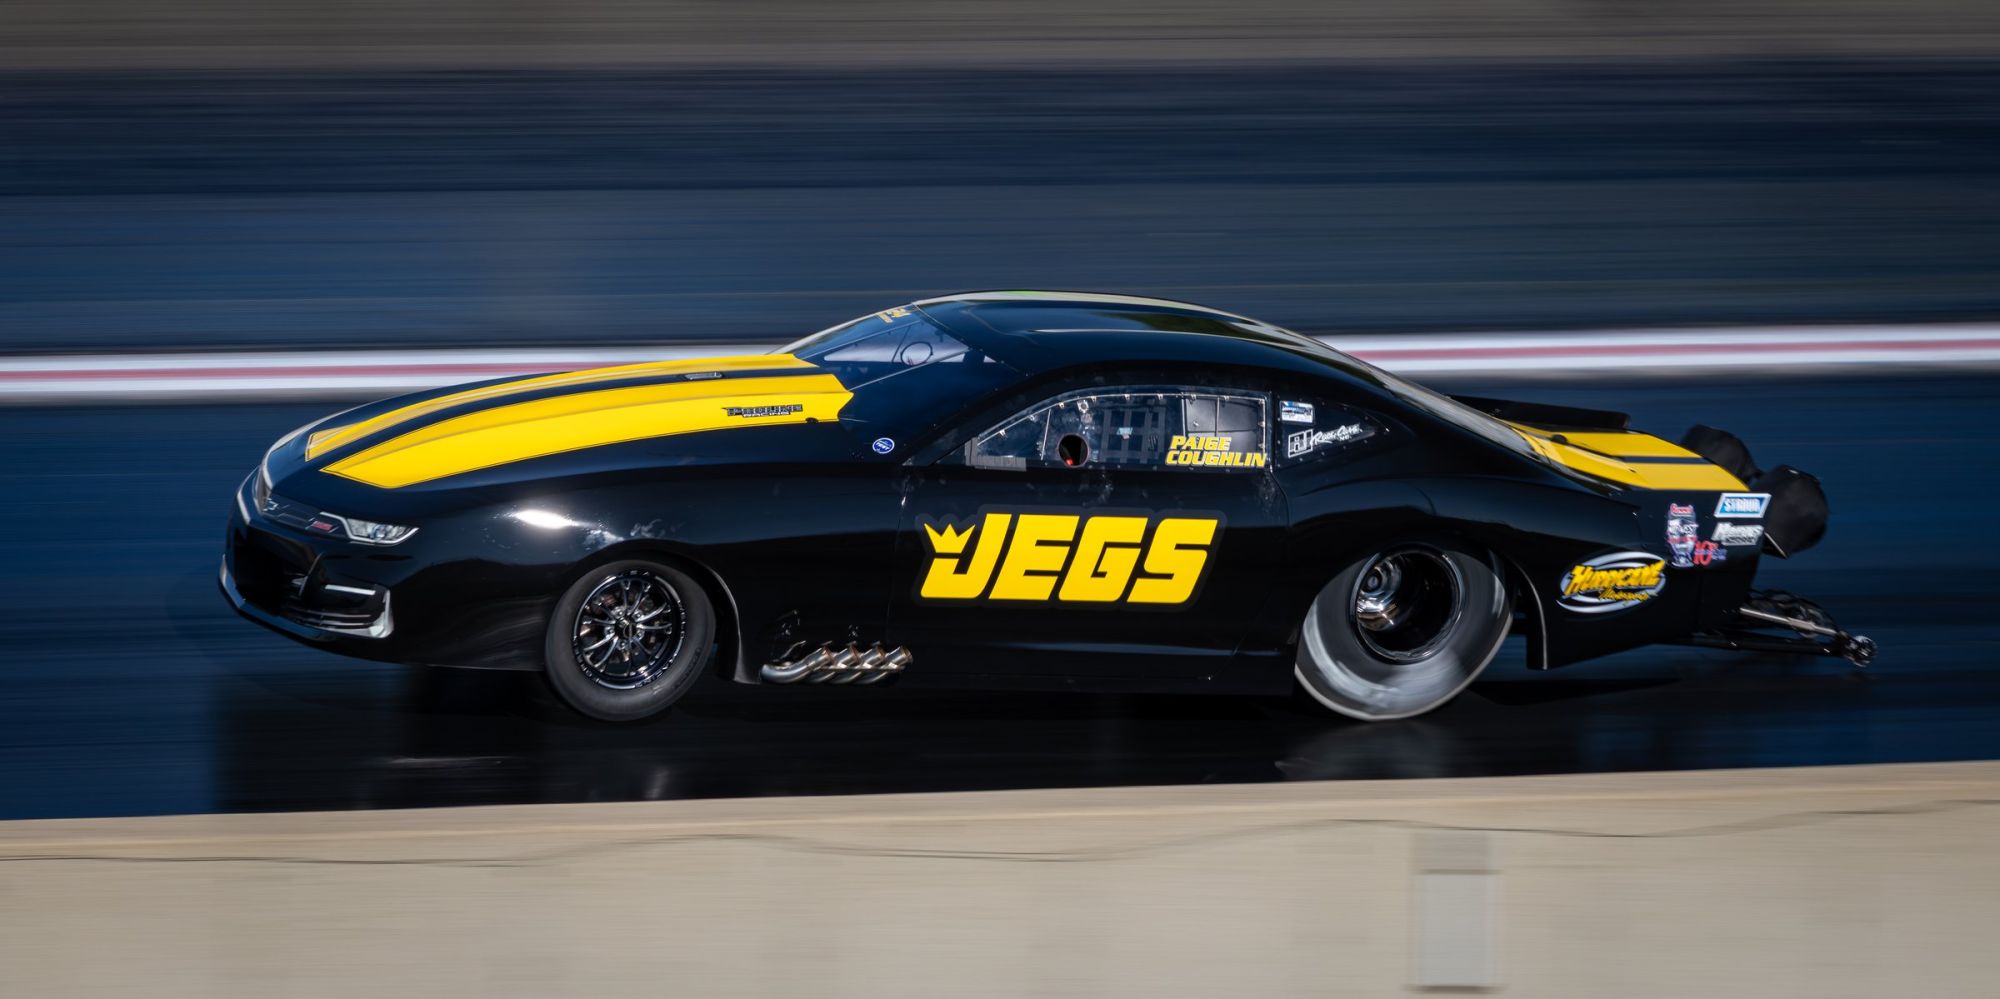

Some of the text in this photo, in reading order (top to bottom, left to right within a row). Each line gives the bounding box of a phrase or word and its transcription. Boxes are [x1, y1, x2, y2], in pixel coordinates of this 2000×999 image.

[1170, 435, 1231, 451] PAIGE
[1166, 451, 1267, 467] COUGHLIN
[920, 513, 1218, 604] JEGS
